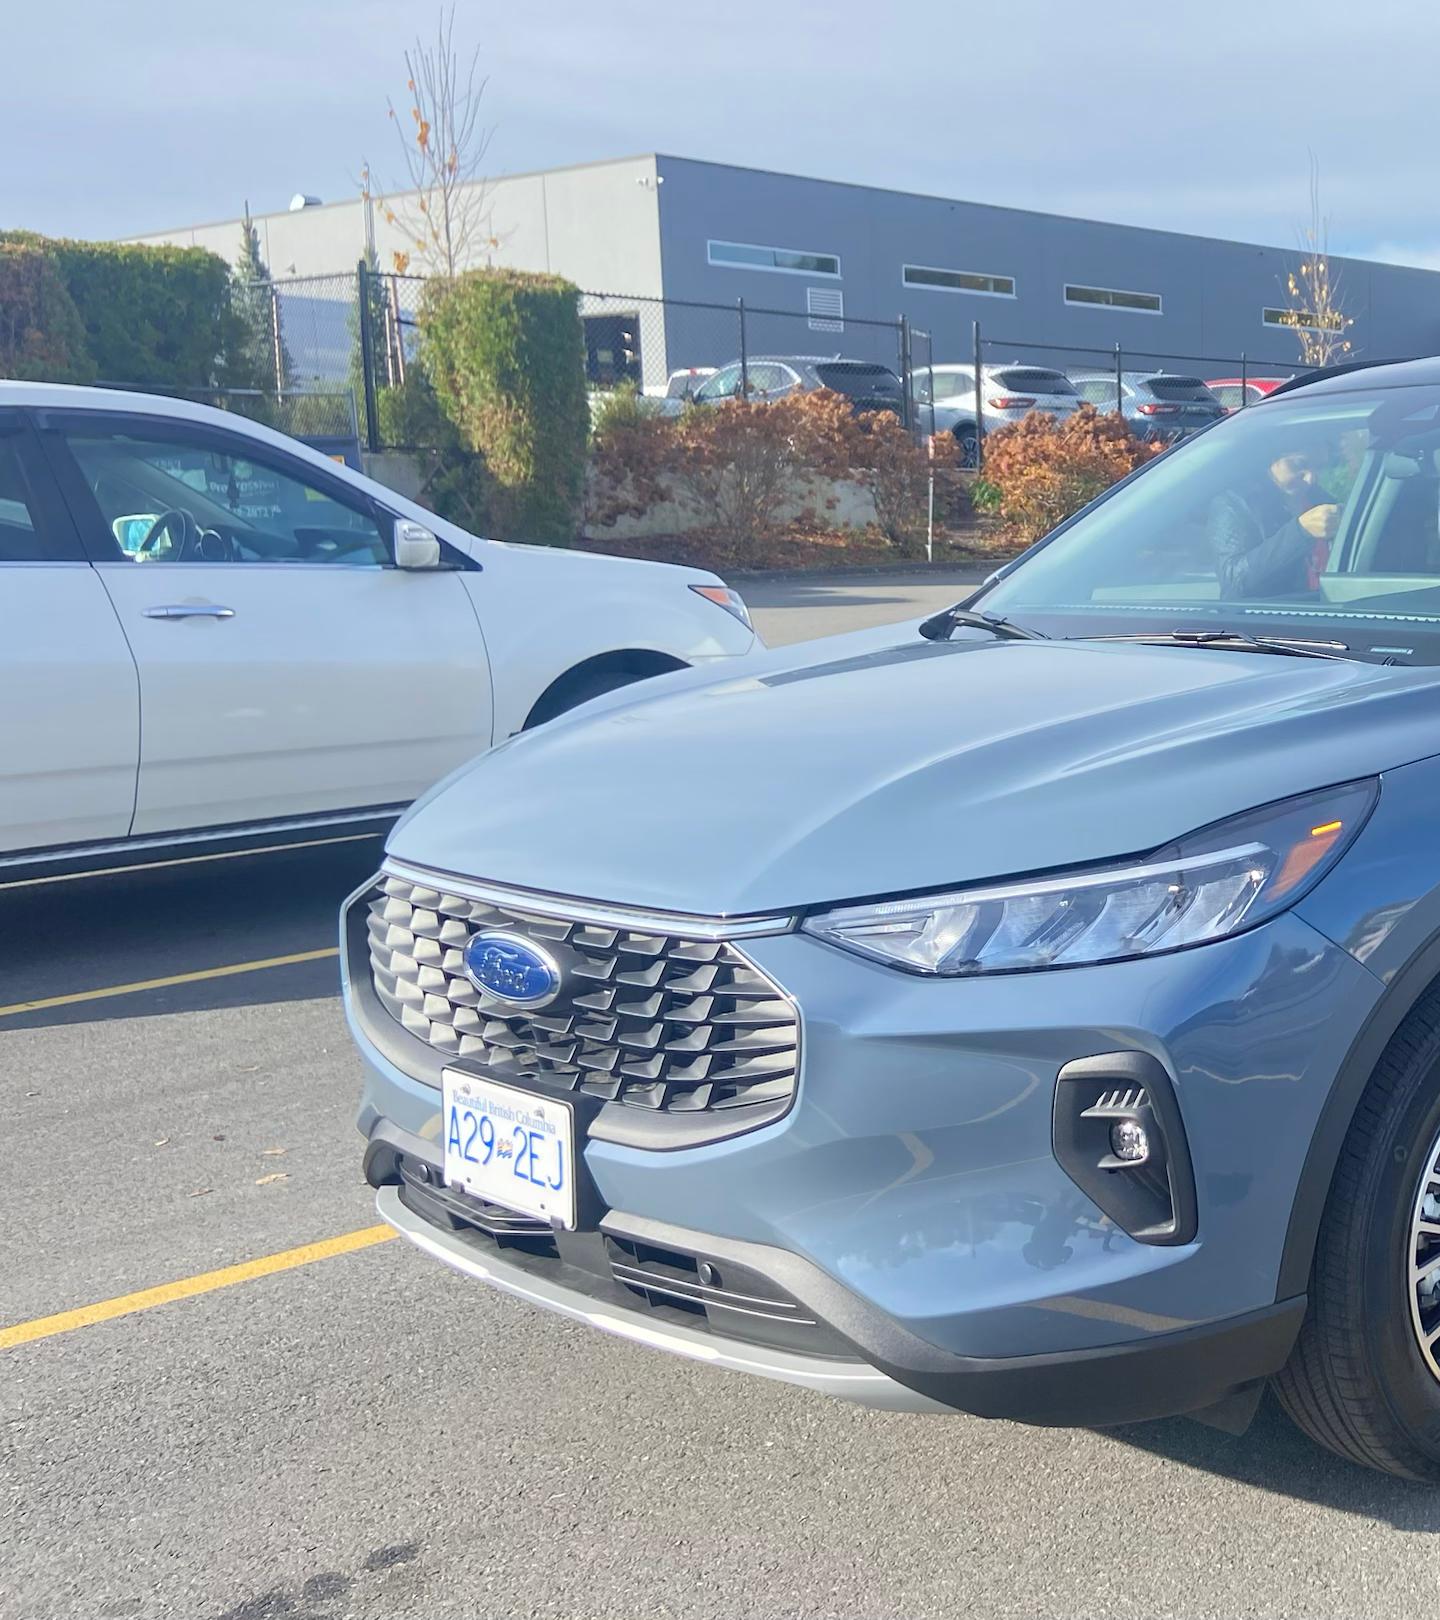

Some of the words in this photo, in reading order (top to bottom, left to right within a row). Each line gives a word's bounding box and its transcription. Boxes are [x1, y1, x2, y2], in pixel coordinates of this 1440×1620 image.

[452, 1088, 488, 1113] Beautiful
[489, 1100, 515, 1122] British
[516, 1109, 556, 1134] Columbia
[448, 1106, 495, 1166] A29
[513, 1126, 564, 1191] 2EJ
